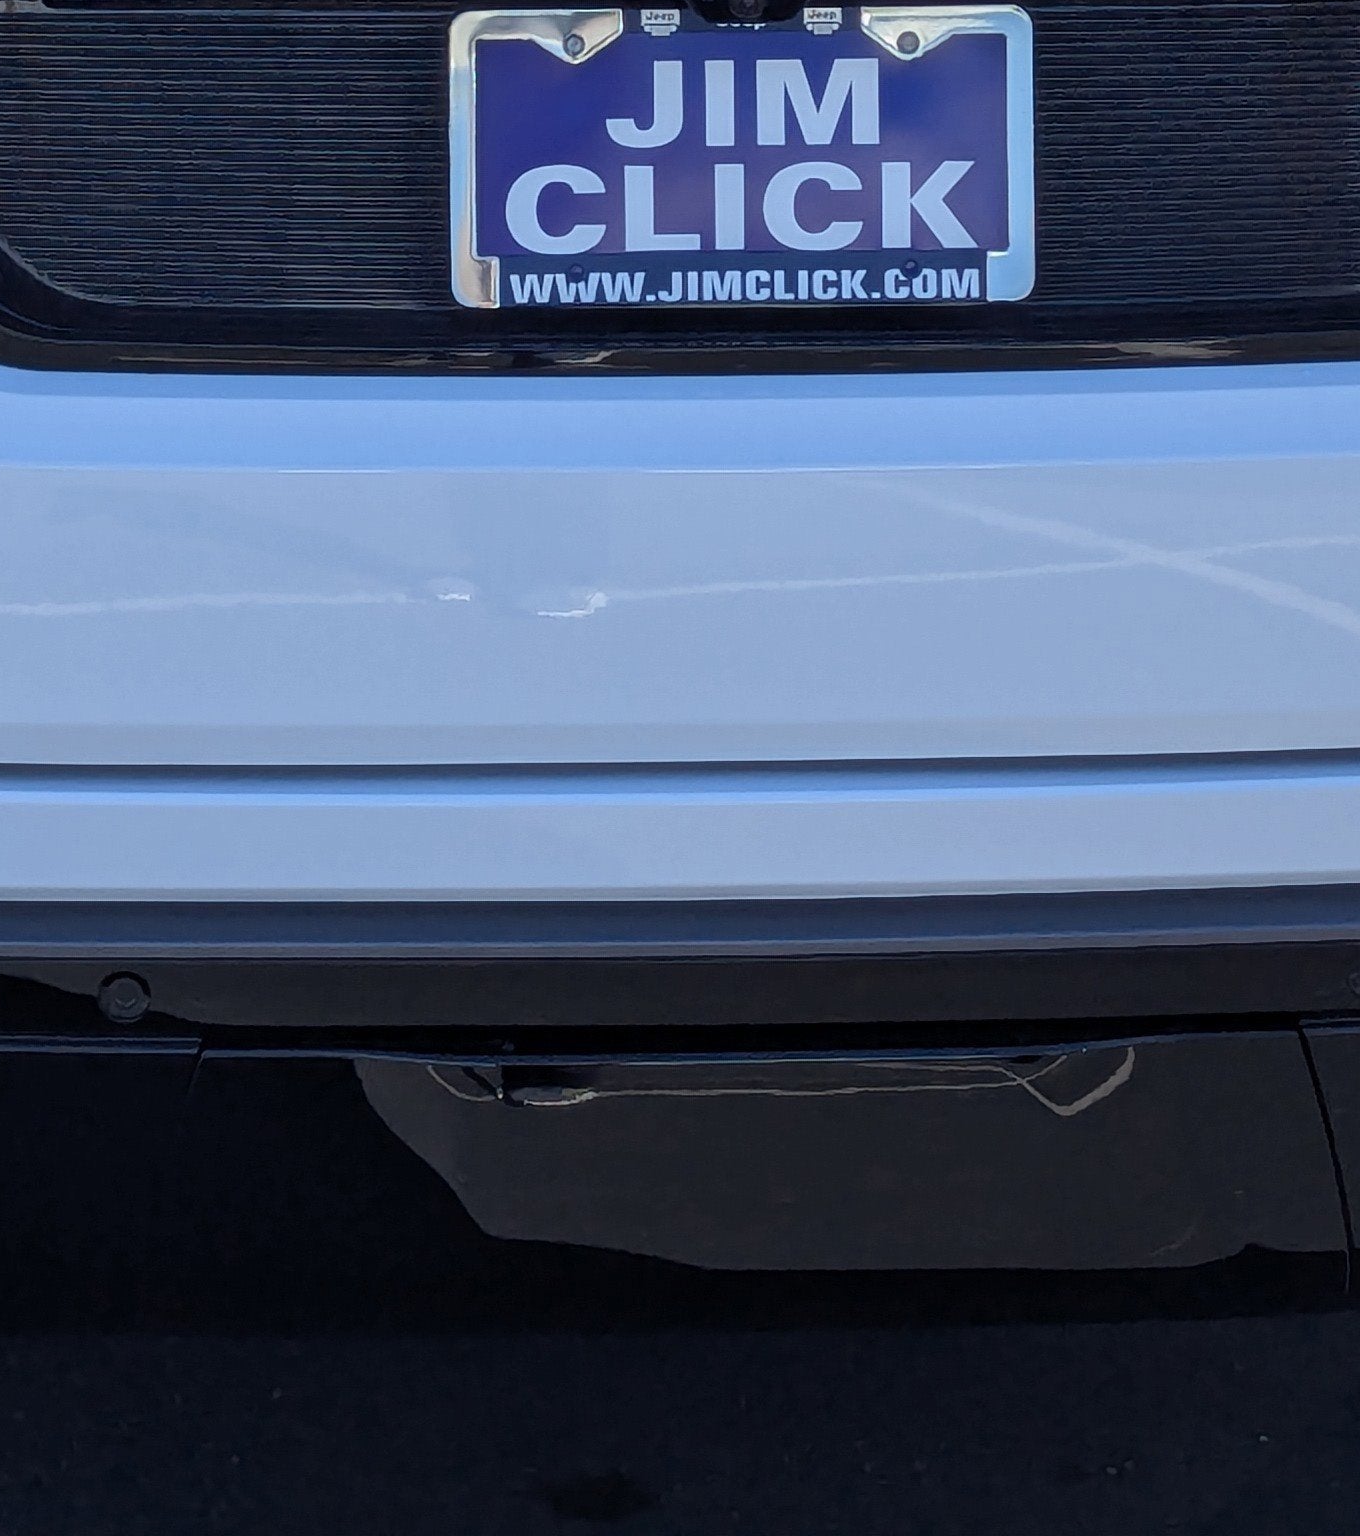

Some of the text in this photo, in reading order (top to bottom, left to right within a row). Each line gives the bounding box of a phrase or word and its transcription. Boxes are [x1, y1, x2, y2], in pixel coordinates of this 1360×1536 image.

[645, 11, 676, 22] Jeep
[807, 9, 838, 21] Jeep
[605, 57, 881, 149] JIM
[504, 160, 979, 255] CLICK
[508, 267, 981, 305] WWW.JIMCLICK.COM
